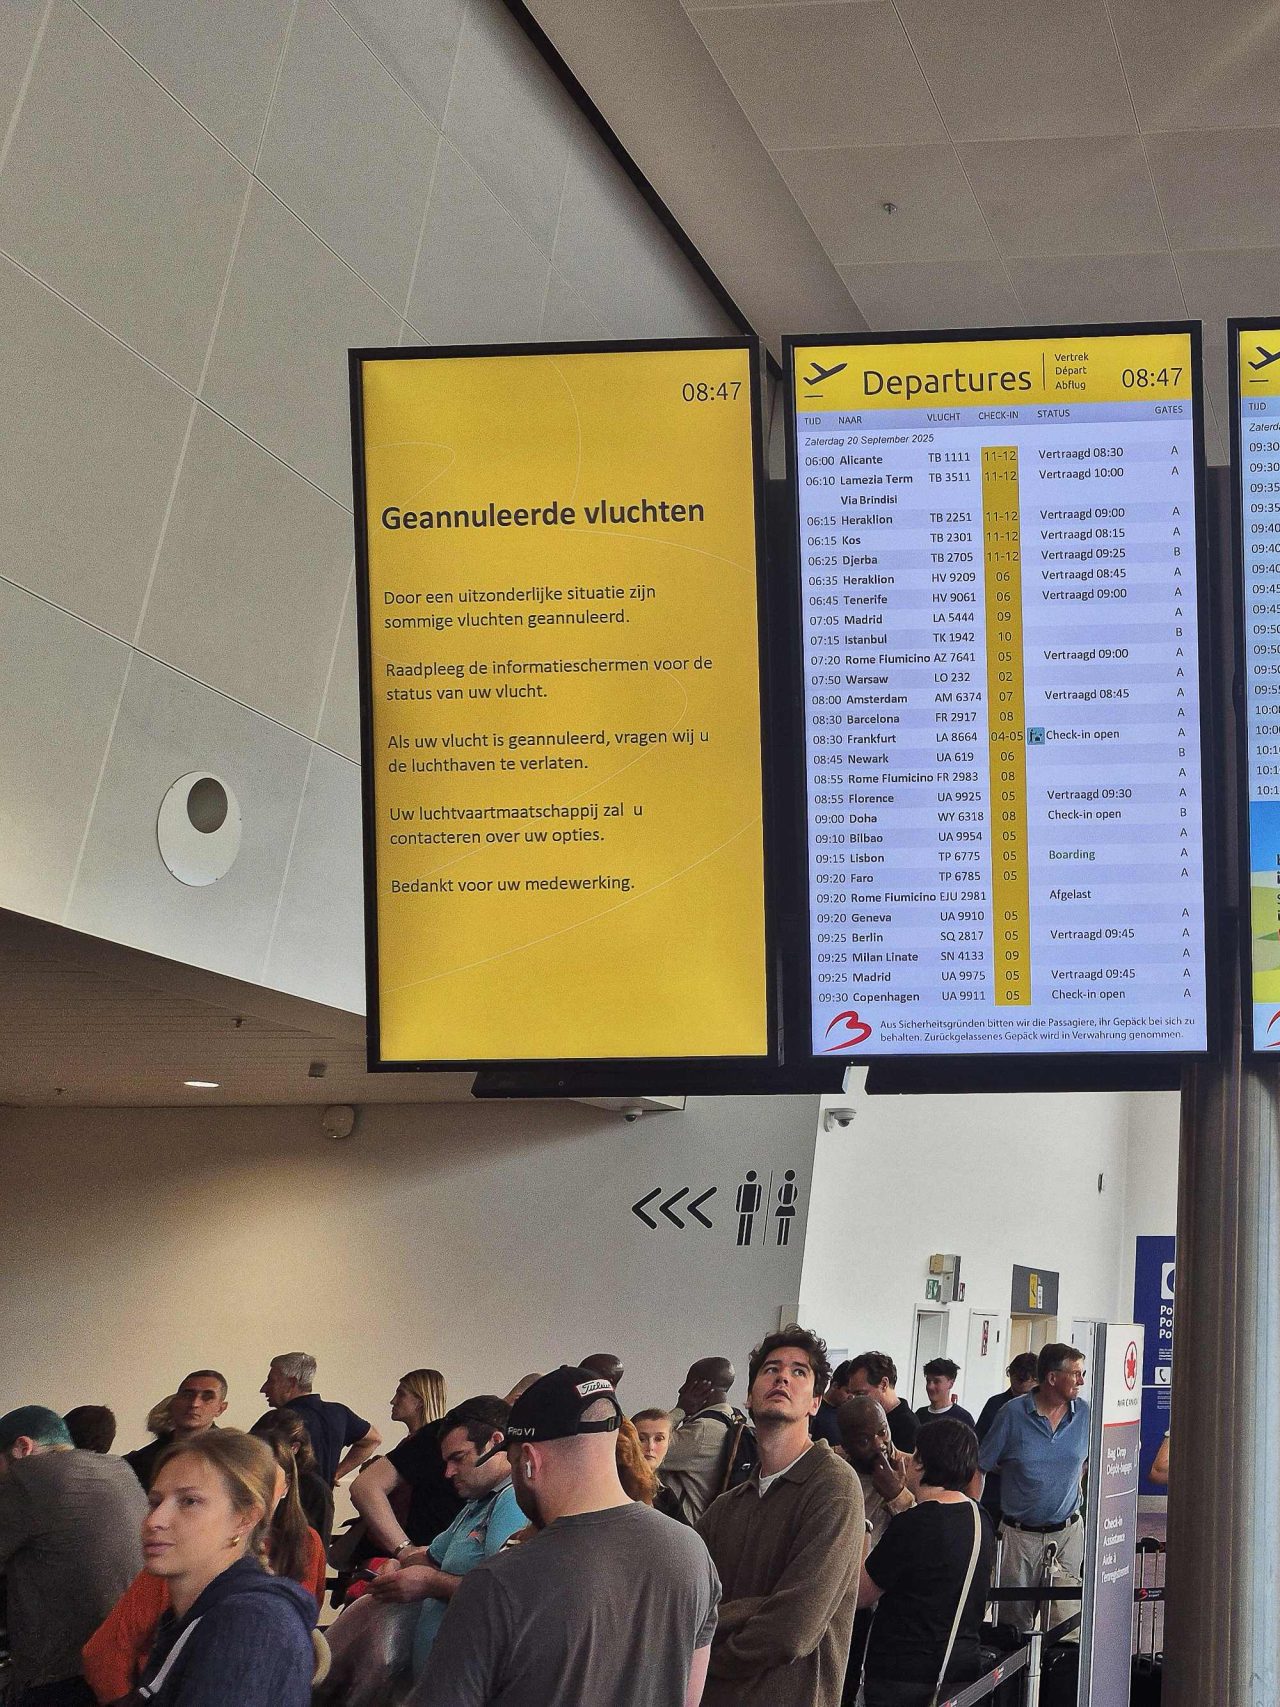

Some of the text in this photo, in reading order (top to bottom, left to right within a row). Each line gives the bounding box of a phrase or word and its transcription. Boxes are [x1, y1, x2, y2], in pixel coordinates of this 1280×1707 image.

[1054, 351, 1089, 362] Vertrek
[1055, 365, 1087, 377] Départ
[1122, 367, 1182, 388] 08:47
[682, 381, 742, 402] 08:47
[863, 368, 1032, 400] Departures
[1055, 379, 1086, 391] Abflug
[804, 405, 1183, 425] TIJD NAAR VLUCHT CHECK-IN STATUS GATES
[804, 433, 934, 447] Zaterdag 20 September 2025
[804, 445, 1178, 466] 06:00 Alicante TB 1111 11-12 Vertraagd 08:30 A
[381, 499, 704, 530] Geannuleerde vluchten
[384, 584, 656, 604] Door een uitzonderlijke situatie zijn
[384, 608, 630, 631] sommige vluchten geannuleerd.
[386, 655, 712, 679] Raadpleeg de informatieschermen voor de
[386, 683, 547, 701] status van uw vlucht.
[387, 728, 708, 749] Als uw vlucht is geannuleerd, vragen wij u
[388, 755, 588, 772] de luchthaven te verlaten.
[390, 802, 642, 821] Uw luchtvaartmaatschappij zal u
[390, 827, 604, 845] contacteren over uw opties.
[815, 847, 1188, 863] 09:15 Lisbon TP 6775 05 Boarding A
[391, 874, 634, 893] Bedankt voor uw medewerking.
